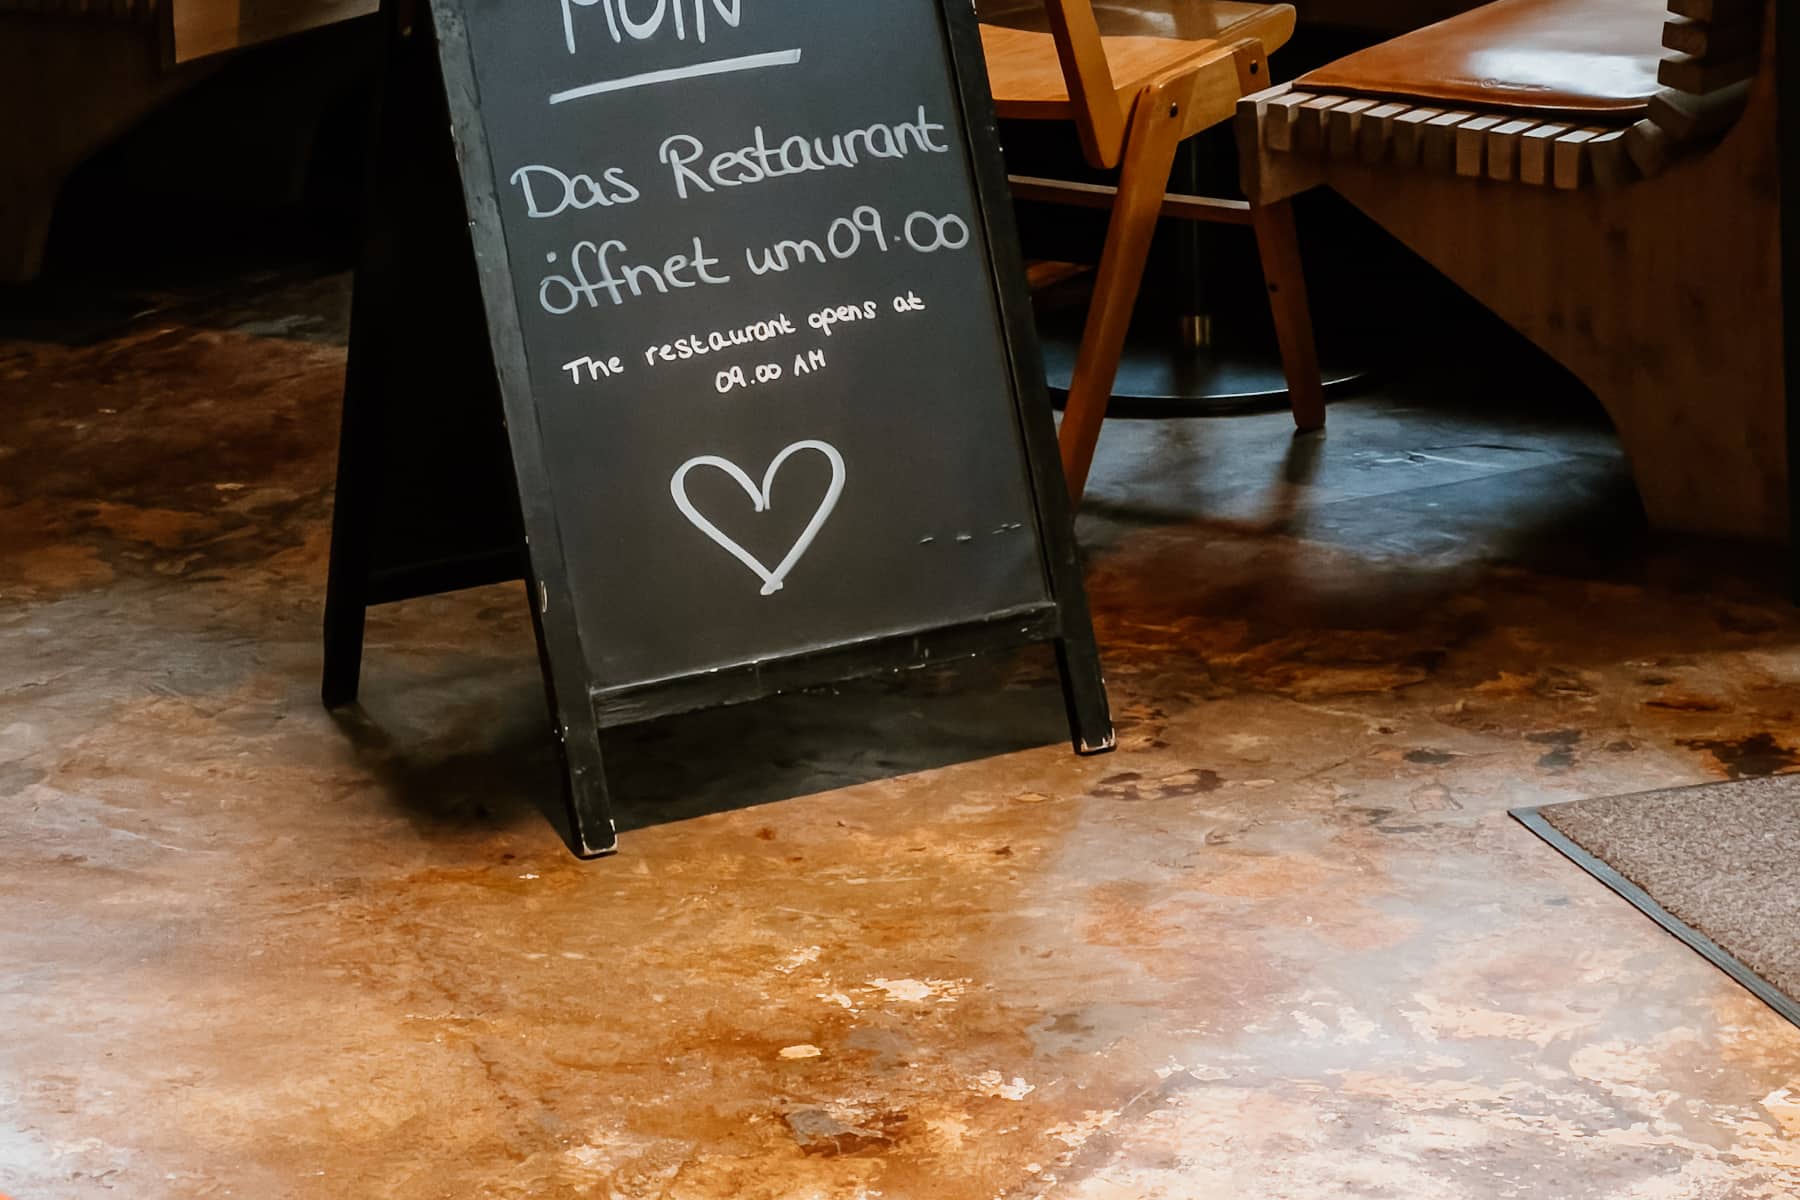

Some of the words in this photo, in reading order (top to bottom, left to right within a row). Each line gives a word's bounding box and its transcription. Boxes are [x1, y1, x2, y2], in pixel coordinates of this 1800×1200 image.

[510, 164, 640, 218] Das
[658, 105, 949, 199] Restaurant
[539, 236, 731, 315] öffnet
[563, 356, 625, 385] The
[645, 313, 797, 366] restaurant
[807, 300, 878, 337] opens
[892, 290, 926, 313] at
[715, 363, 783, 393] 09.00
[793, 348, 827, 377] AM
